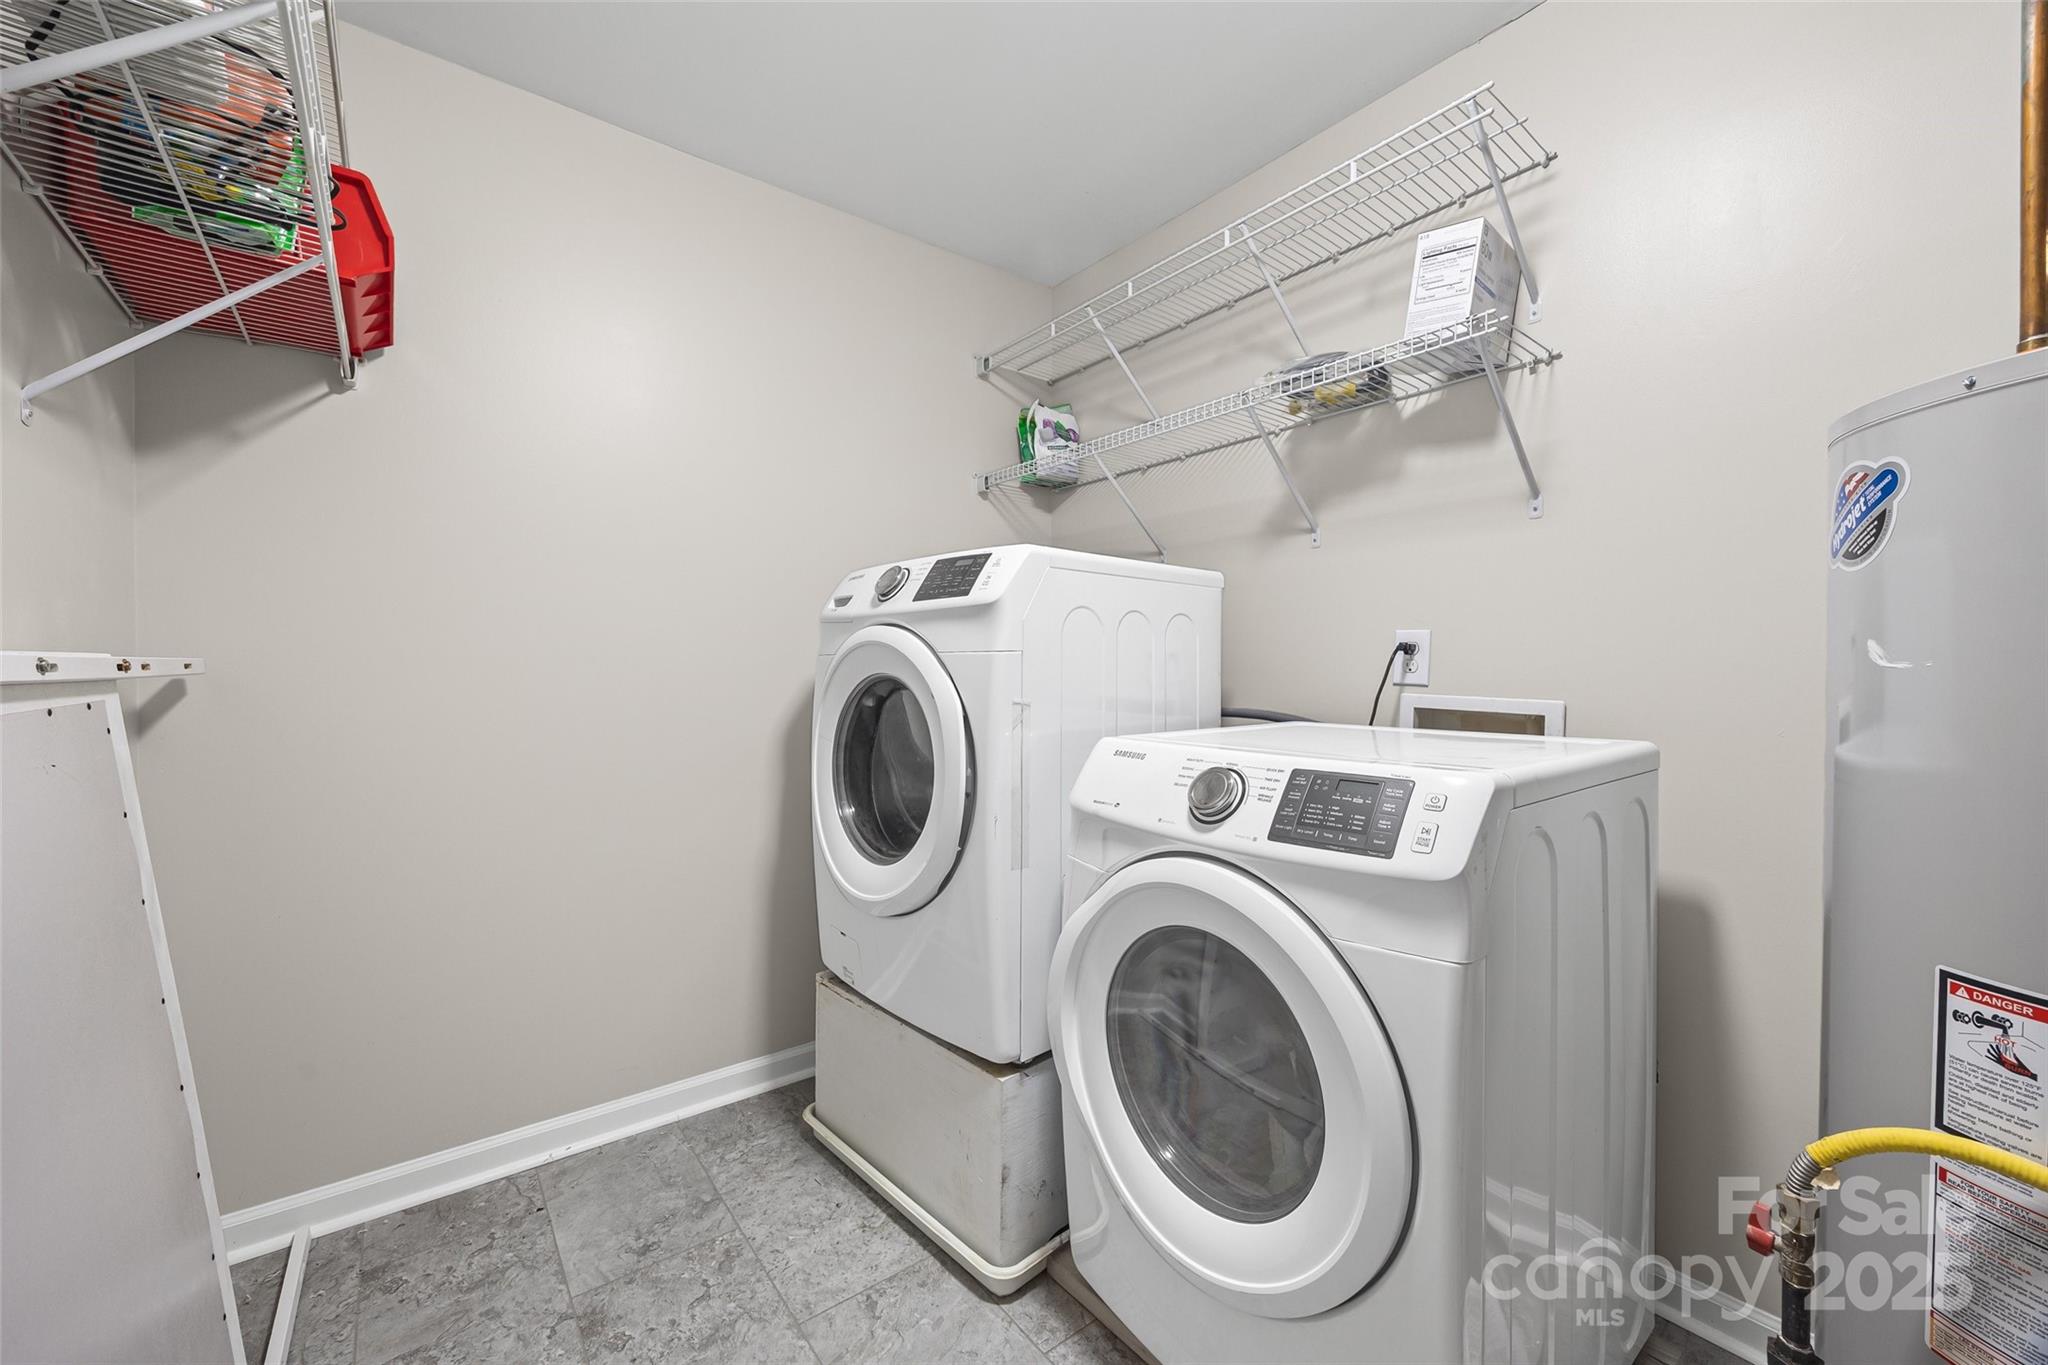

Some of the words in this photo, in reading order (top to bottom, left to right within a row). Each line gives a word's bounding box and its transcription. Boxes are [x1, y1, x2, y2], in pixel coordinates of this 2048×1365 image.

[1113, 749, 1147, 760] SAMSUNG
[1973, 991, 2034, 1017] DANGER
[1994, 1035, 2016, 1048] HOT
[1948, 1178, 1967, 1193] READ
[1968, 1190, 1997, 1206] BEFORE
[1999, 1204, 2047, 1229] OPERATING
[1961, 1180, 1975, 1191] FOR
[1977, 1188, 1998, 1200] YOUR
[2000, 1198, 2030, 1216] SAFETY
